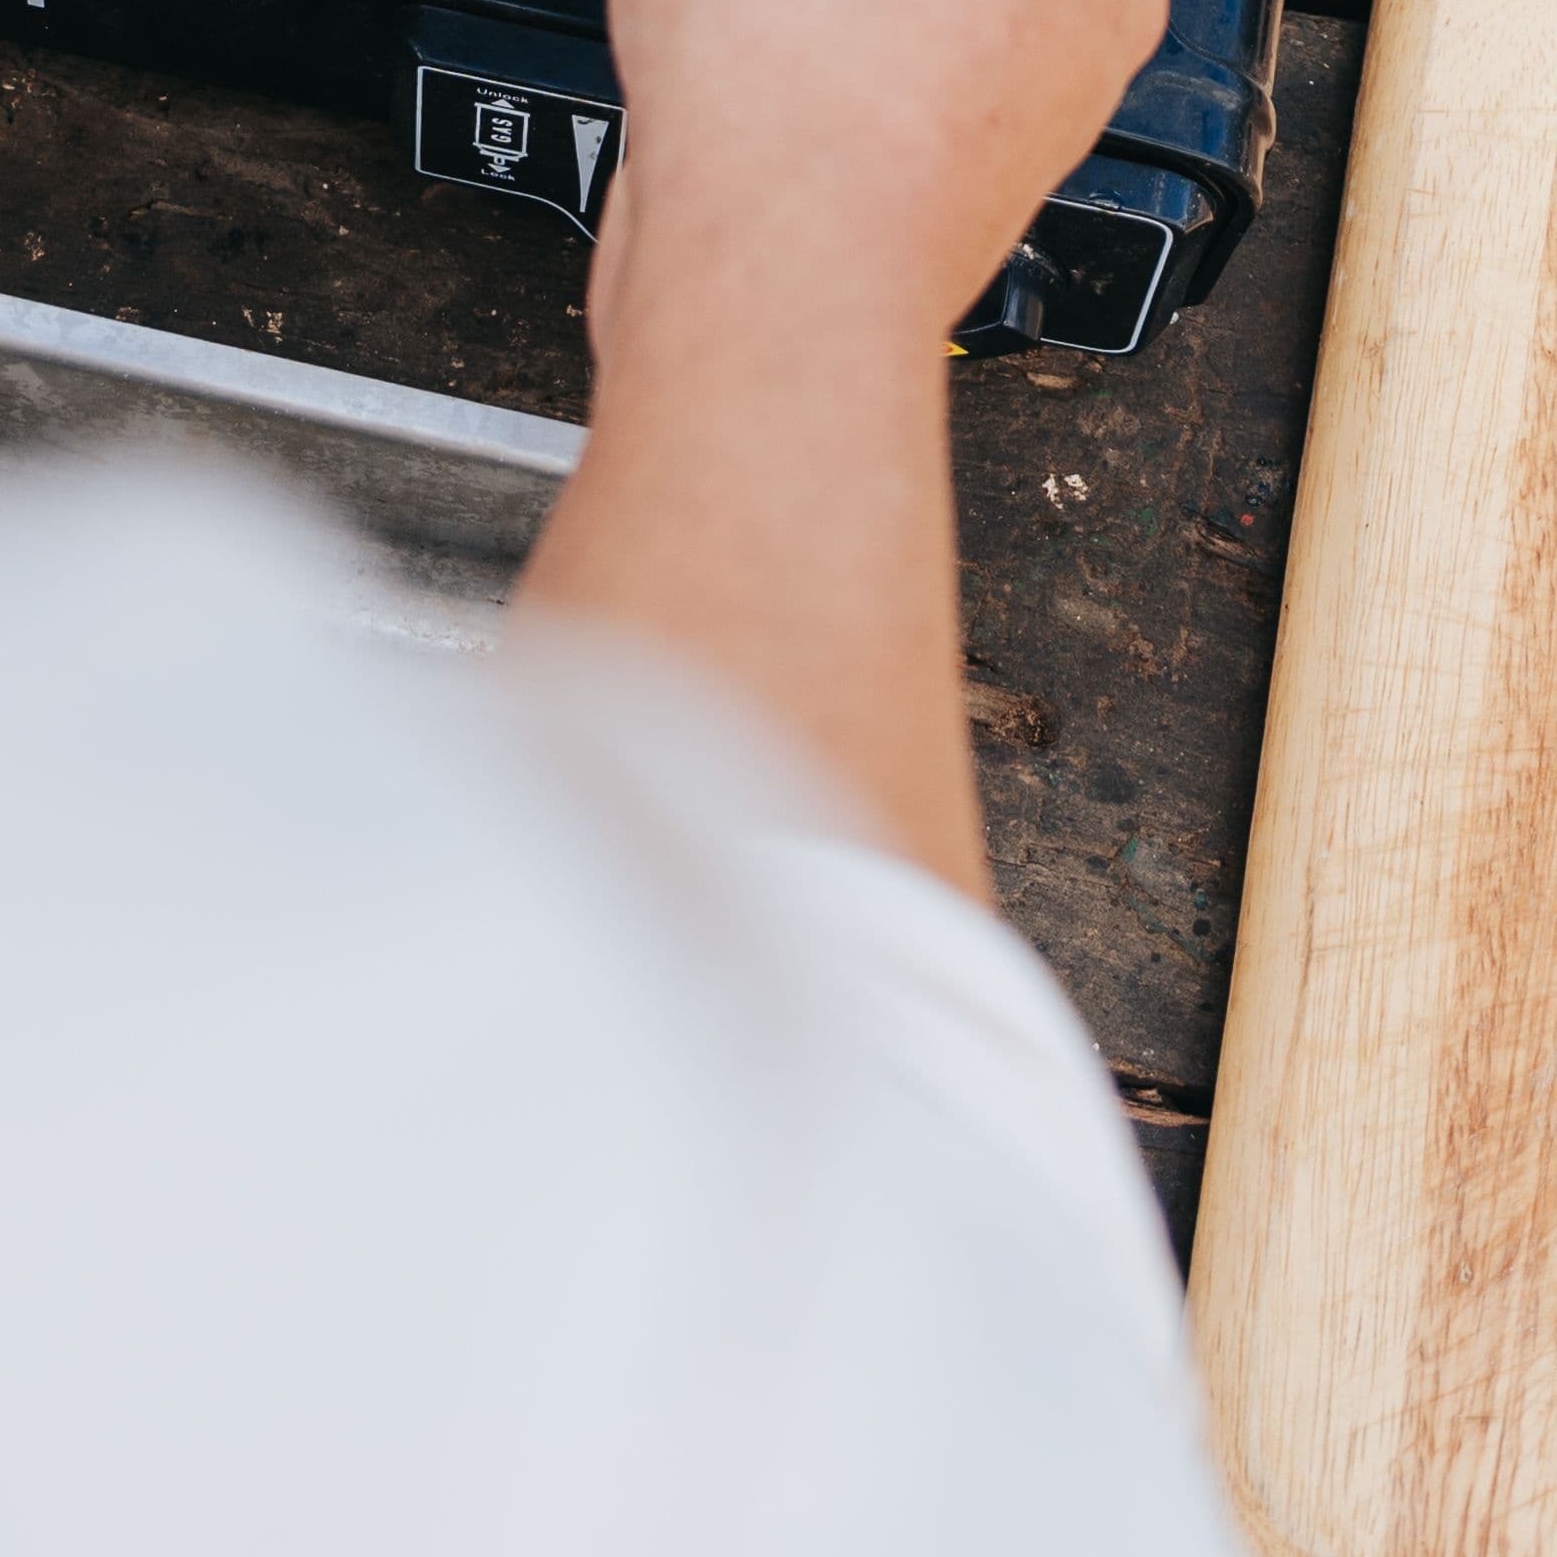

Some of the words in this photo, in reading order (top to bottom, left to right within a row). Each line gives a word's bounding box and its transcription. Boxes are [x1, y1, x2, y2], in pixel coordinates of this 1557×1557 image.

[476, 87, 529, 104] Unlock
[491, 117, 513, 143] GAS
[480, 168, 516, 182] Lock
